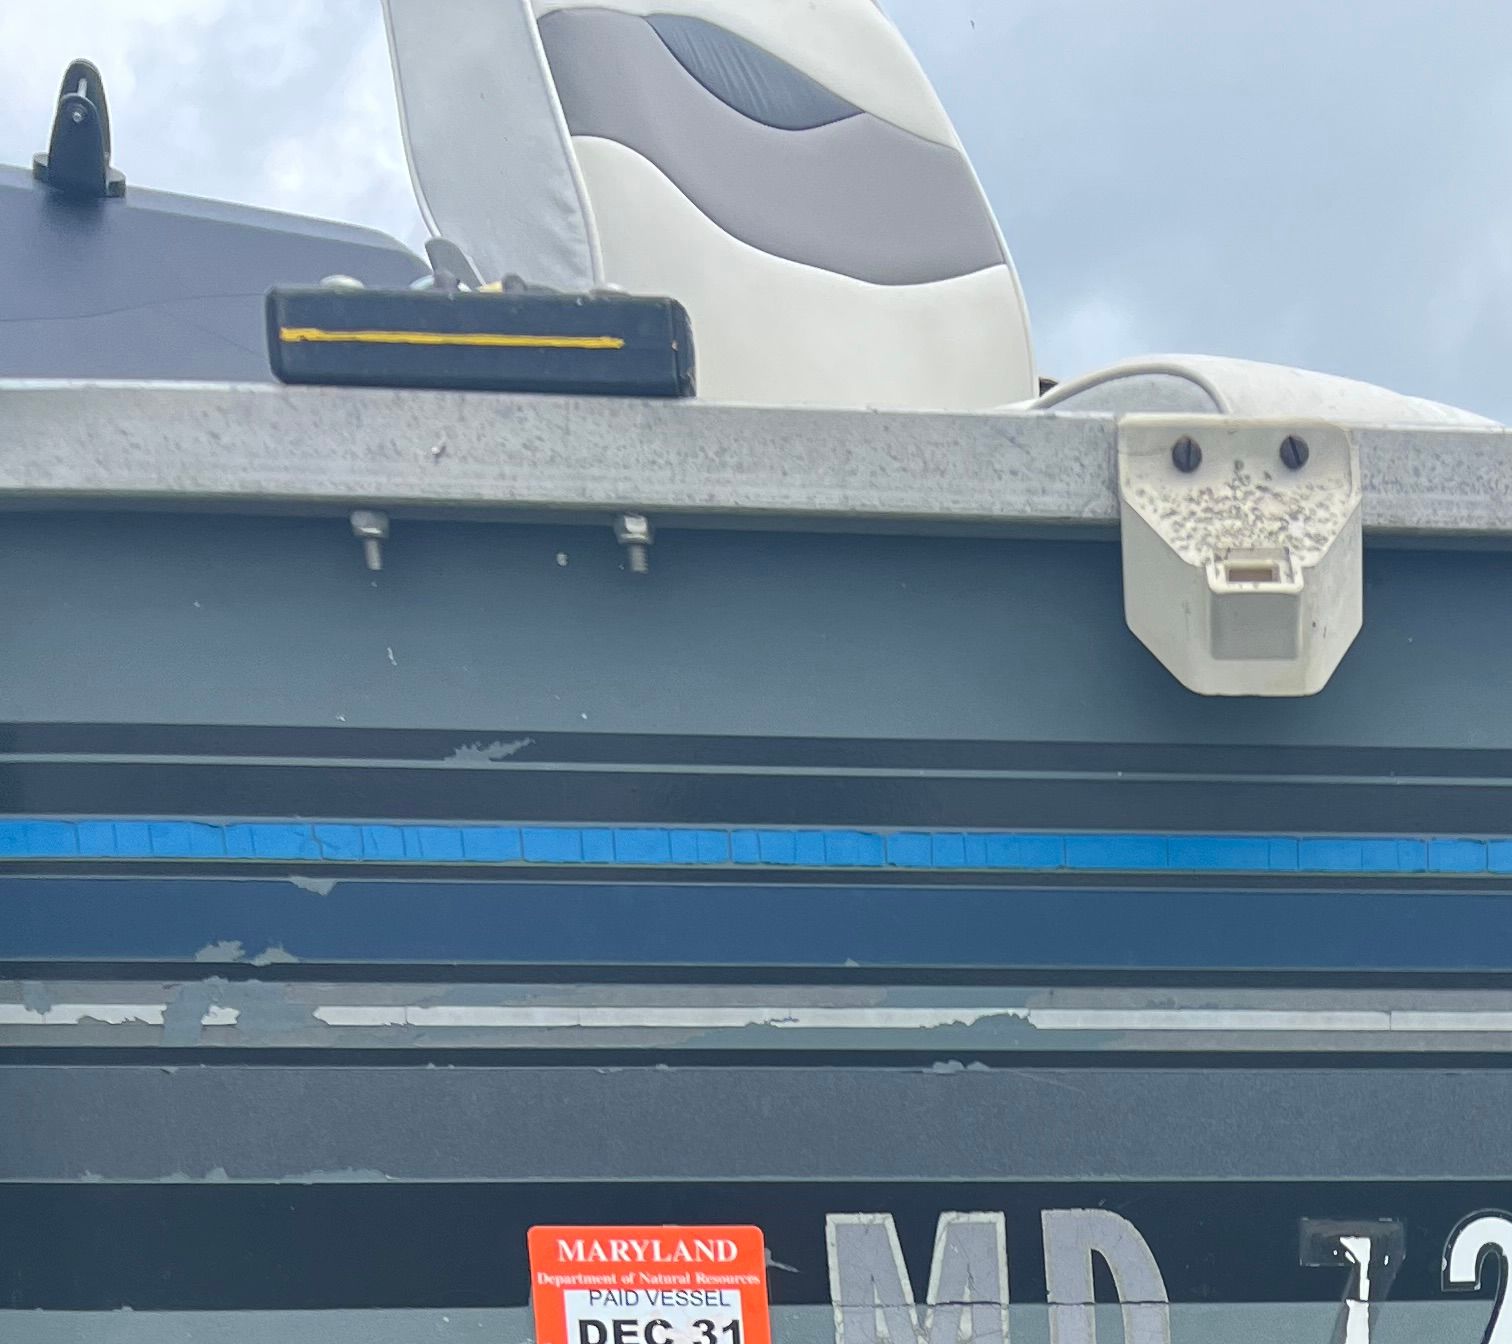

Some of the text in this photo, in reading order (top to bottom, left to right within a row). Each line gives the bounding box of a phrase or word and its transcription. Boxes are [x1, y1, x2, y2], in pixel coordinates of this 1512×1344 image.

[557, 1239, 738, 1262] MARYLAND
[537, 1272, 761, 1287] Department of Natural Resources
[589, 1290, 731, 1306] PAID VESSEL
